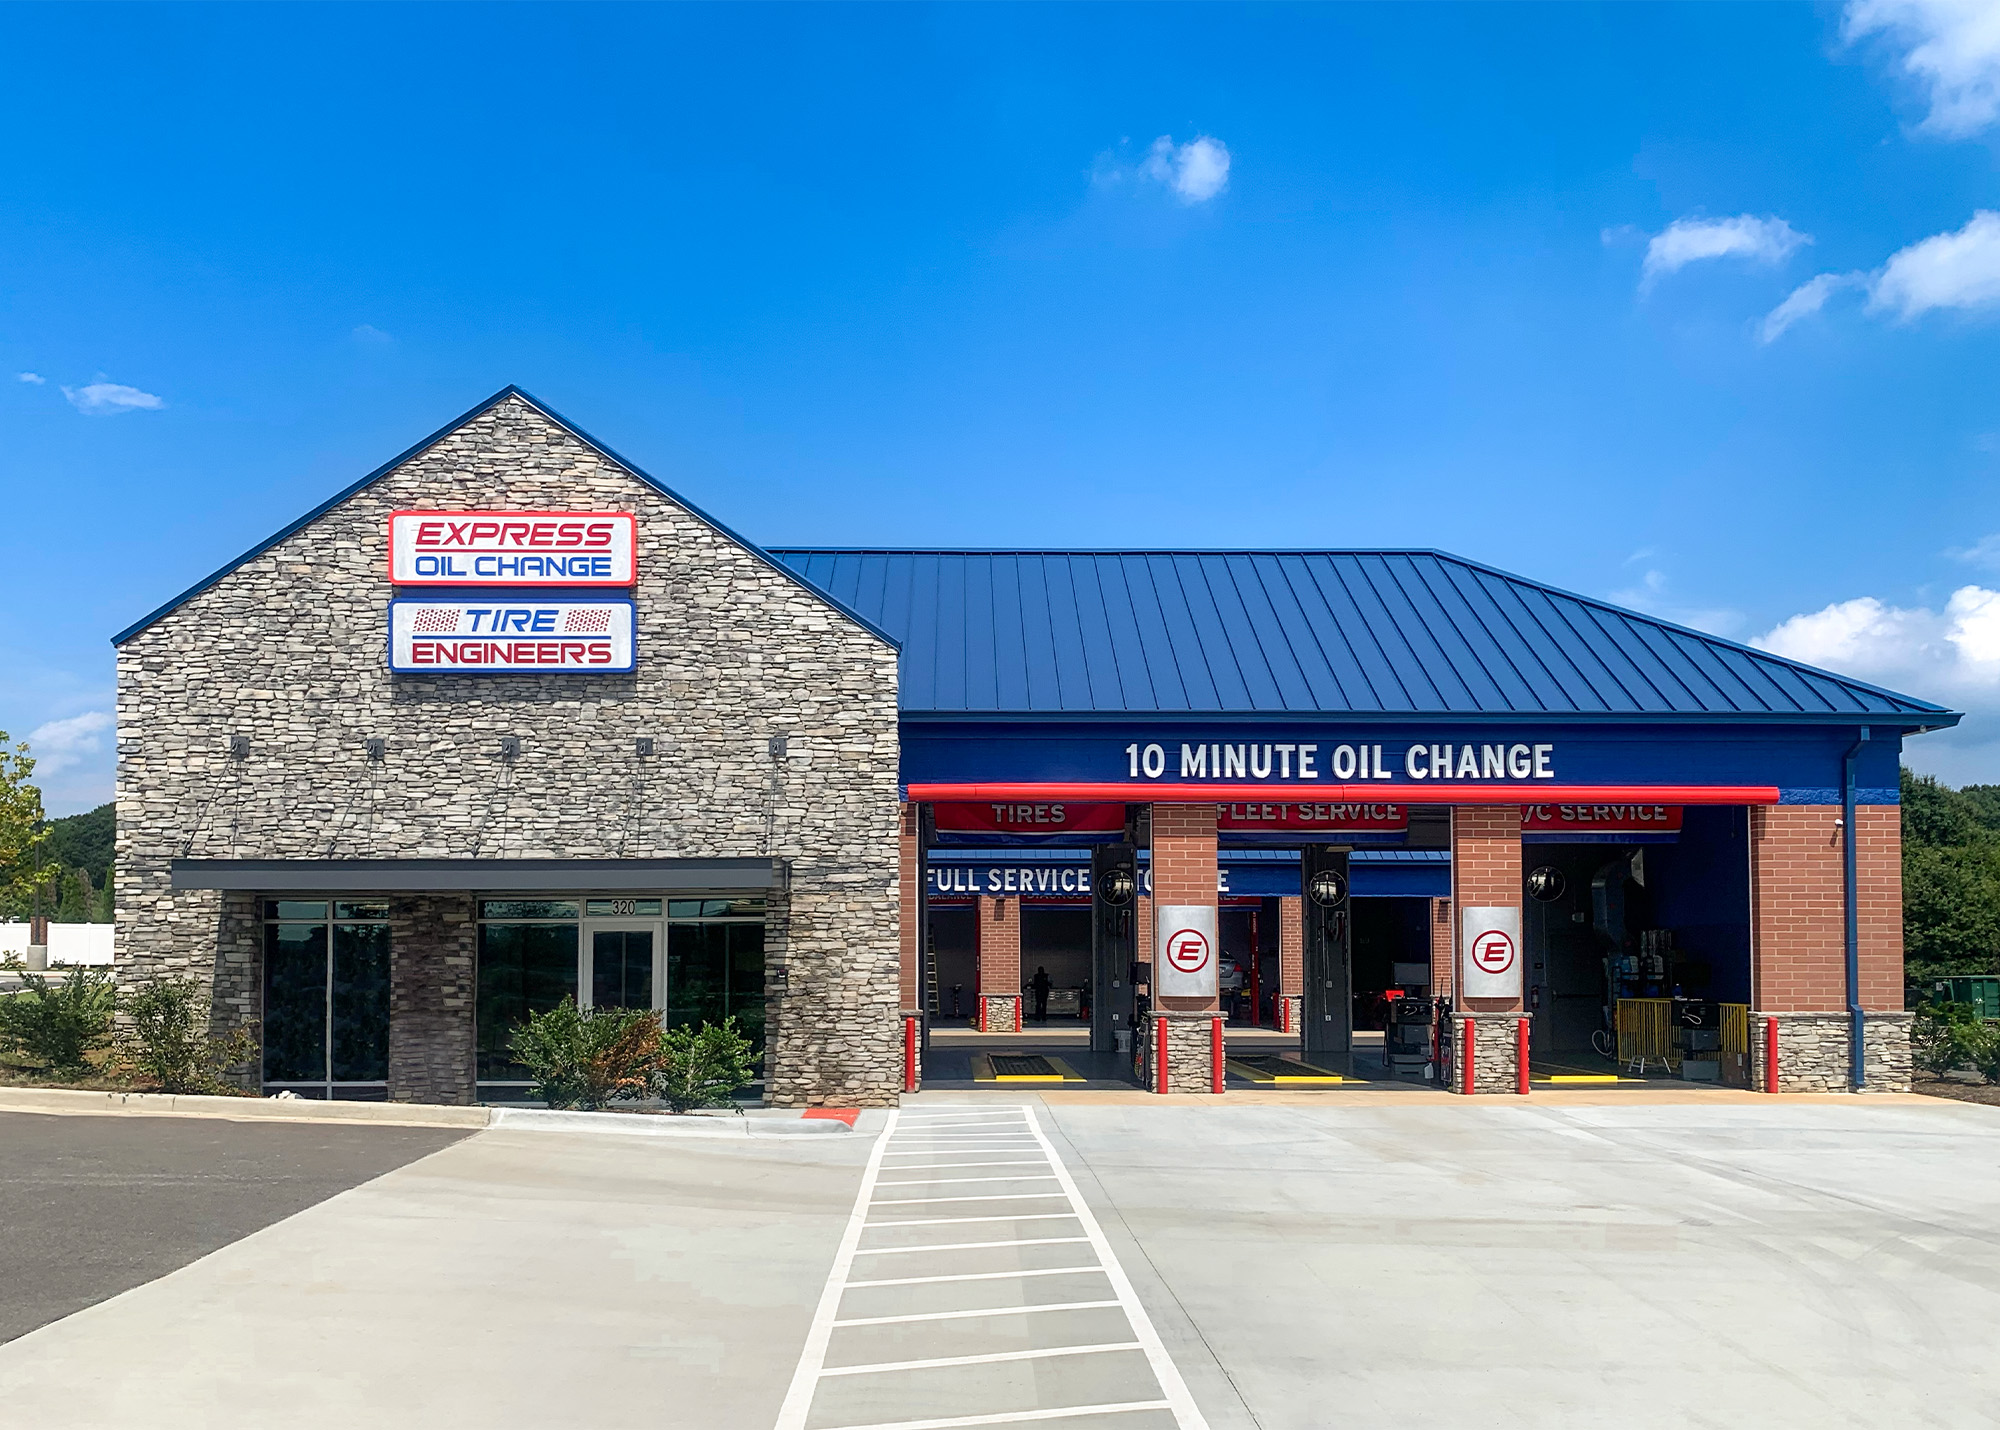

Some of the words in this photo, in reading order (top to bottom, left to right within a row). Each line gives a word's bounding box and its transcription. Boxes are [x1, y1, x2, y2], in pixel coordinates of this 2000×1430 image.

[415, 522, 614, 546] EXPRESS
[415, 556, 467, 576] OIL
[474, 556, 612, 577] CHANGE
[466, 609, 560, 632] TIRE
[412, 642, 612, 664] ENGINEERS
[1126, 743, 1165, 779] 10
[1180, 743, 1318, 779] MINUTE
[1332, 744, 1391, 779] OIL
[1405, 743, 1555, 779] CHANGE
[991, 804, 1066, 823] TIRES
[1217, 803, 1292, 820] FLEET
[1298, 803, 1401, 820] SERVICE
[1521, 805, 1552, 823] /C
[1560, 805, 1668, 821] SERVICE
[988, 868, 1091, 891] SERVICE
[612, 900, 635, 915] 320
